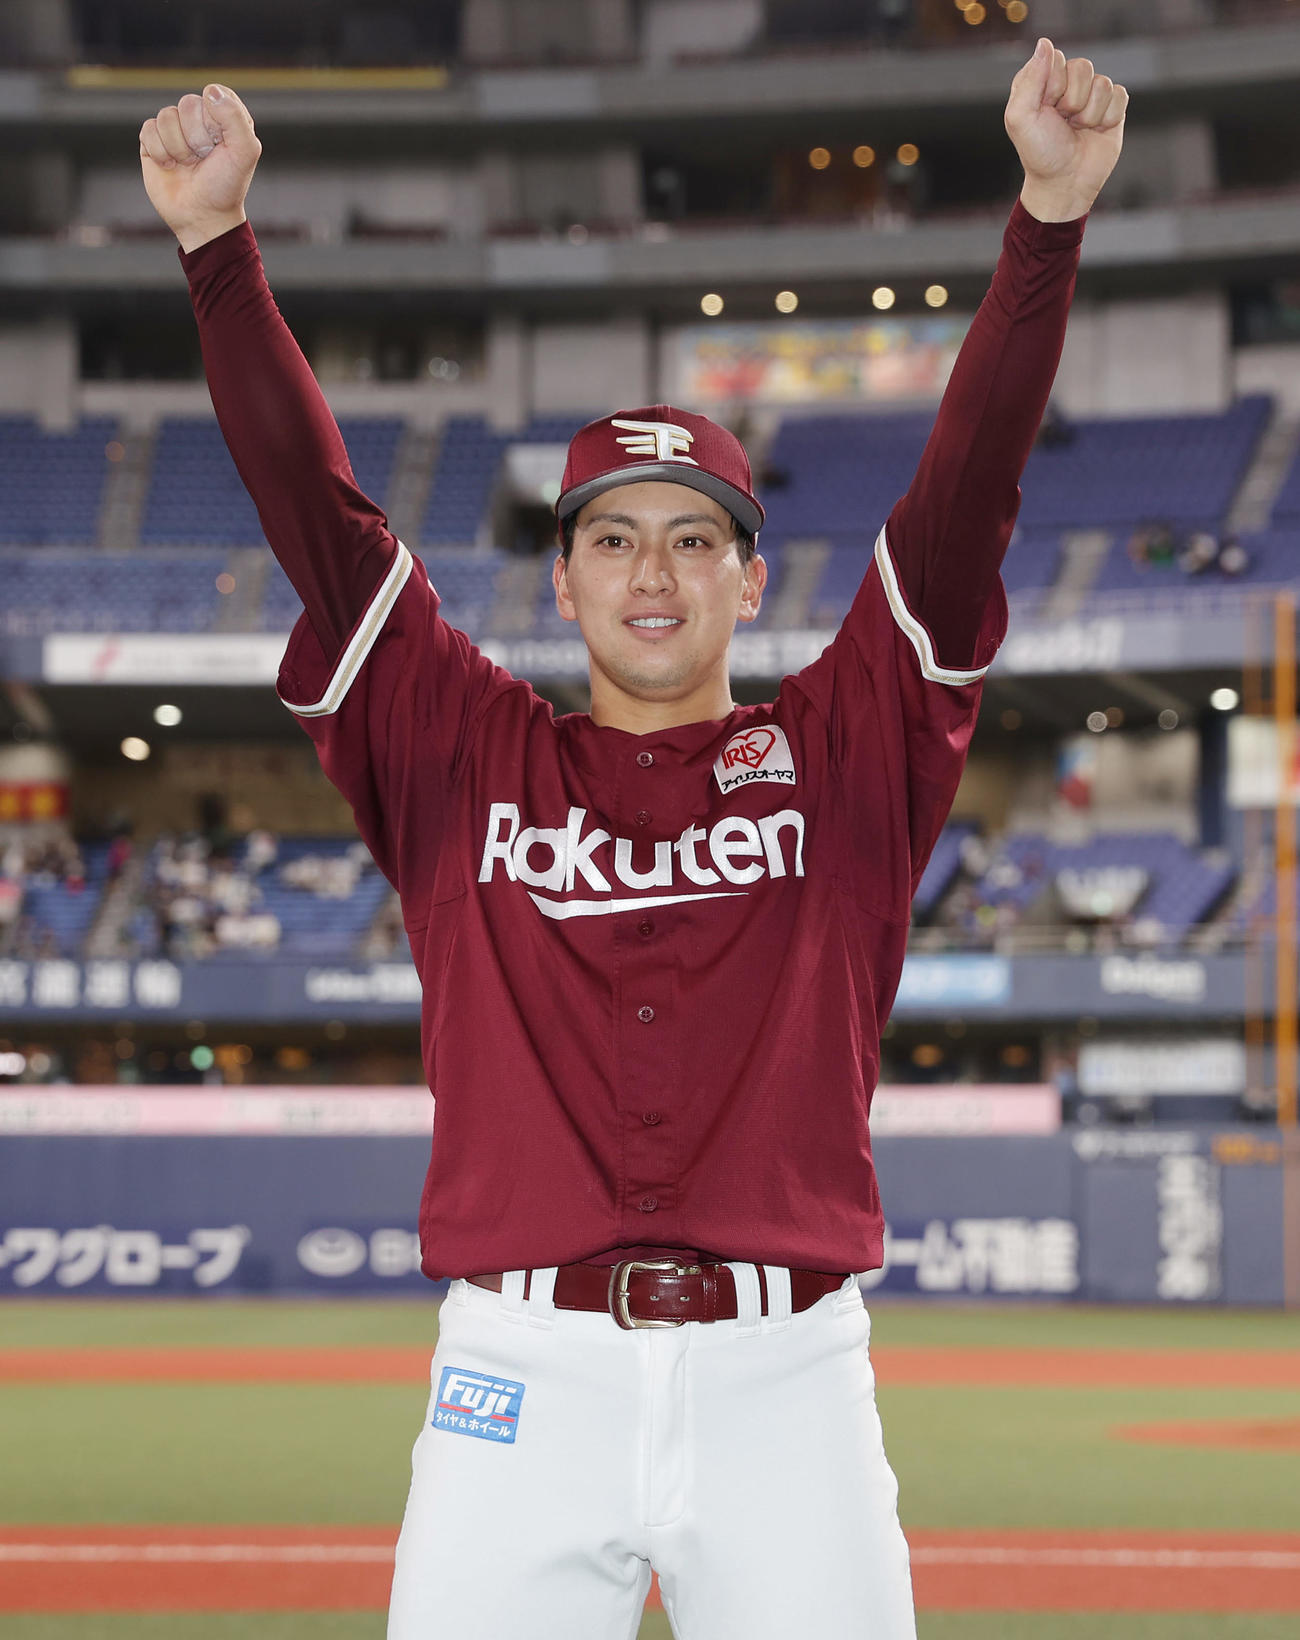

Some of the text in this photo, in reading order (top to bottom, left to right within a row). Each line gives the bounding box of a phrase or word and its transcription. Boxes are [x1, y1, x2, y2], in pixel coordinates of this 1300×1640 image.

[721, 740, 761, 770] IRIS
[721, 769, 794, 792] アイリスオーヤマ
[478, 802, 806, 893] Rakuten
[0, 1225, 252, 1288] ワグローブ
[435, 1410, 511, 1438] タイヤ&ホイール
